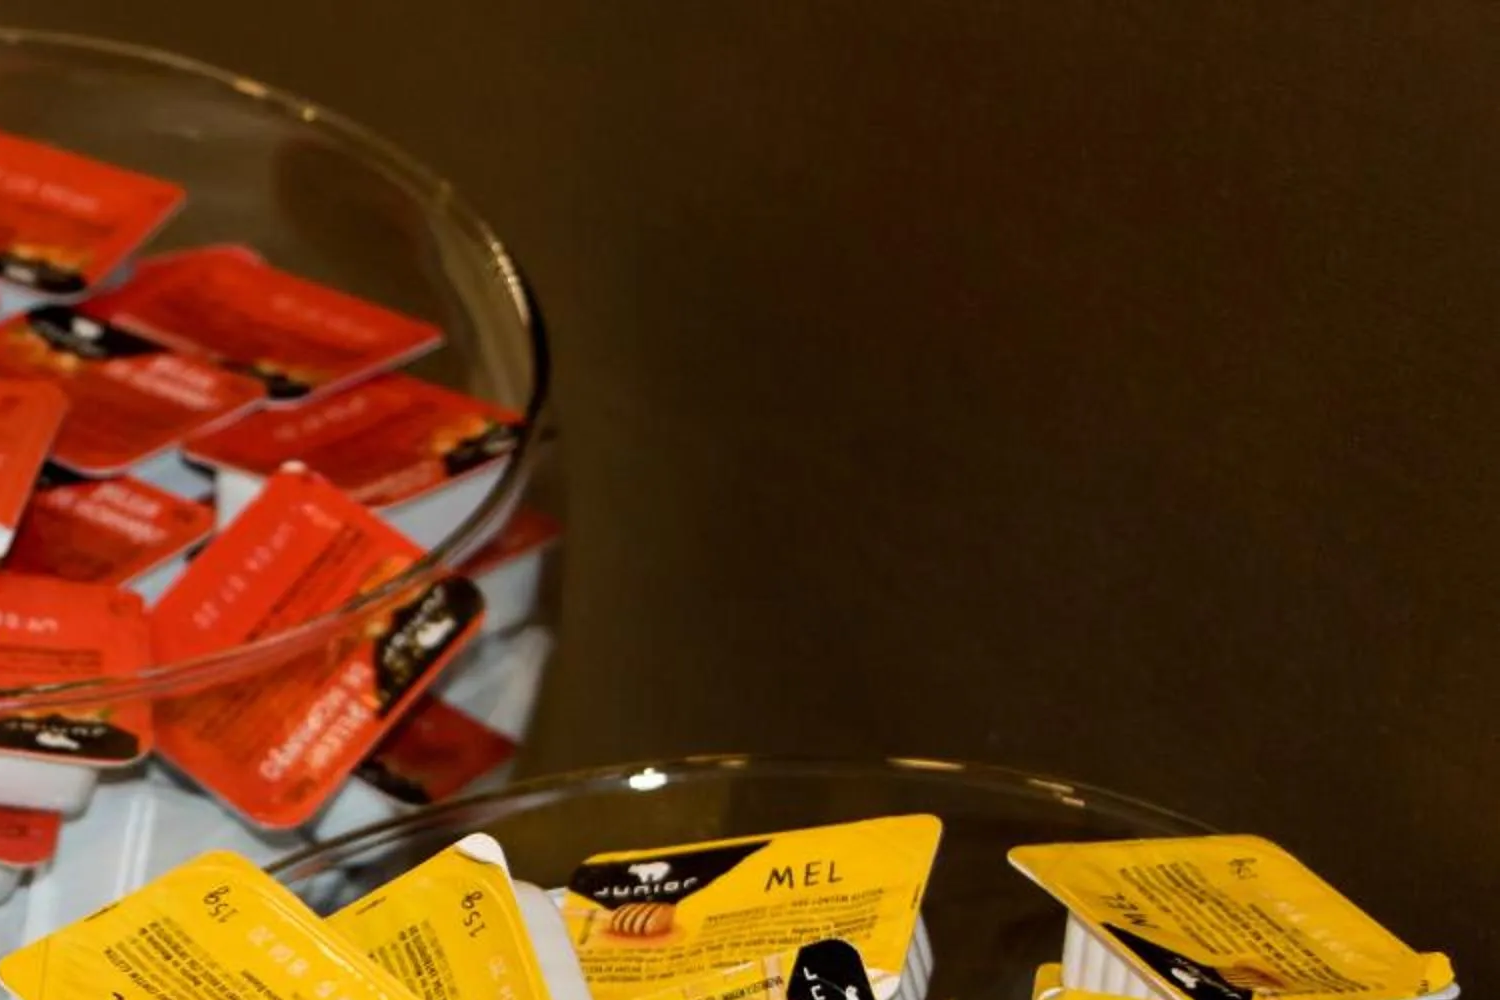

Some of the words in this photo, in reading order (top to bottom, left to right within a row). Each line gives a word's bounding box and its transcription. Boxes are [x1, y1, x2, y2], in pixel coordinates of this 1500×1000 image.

[595, 877, 697, 897] JUNIOR
[764, 861, 842, 892] MEL
[203, 885, 238, 923] 15g
[461, 890, 486, 938] 15g
